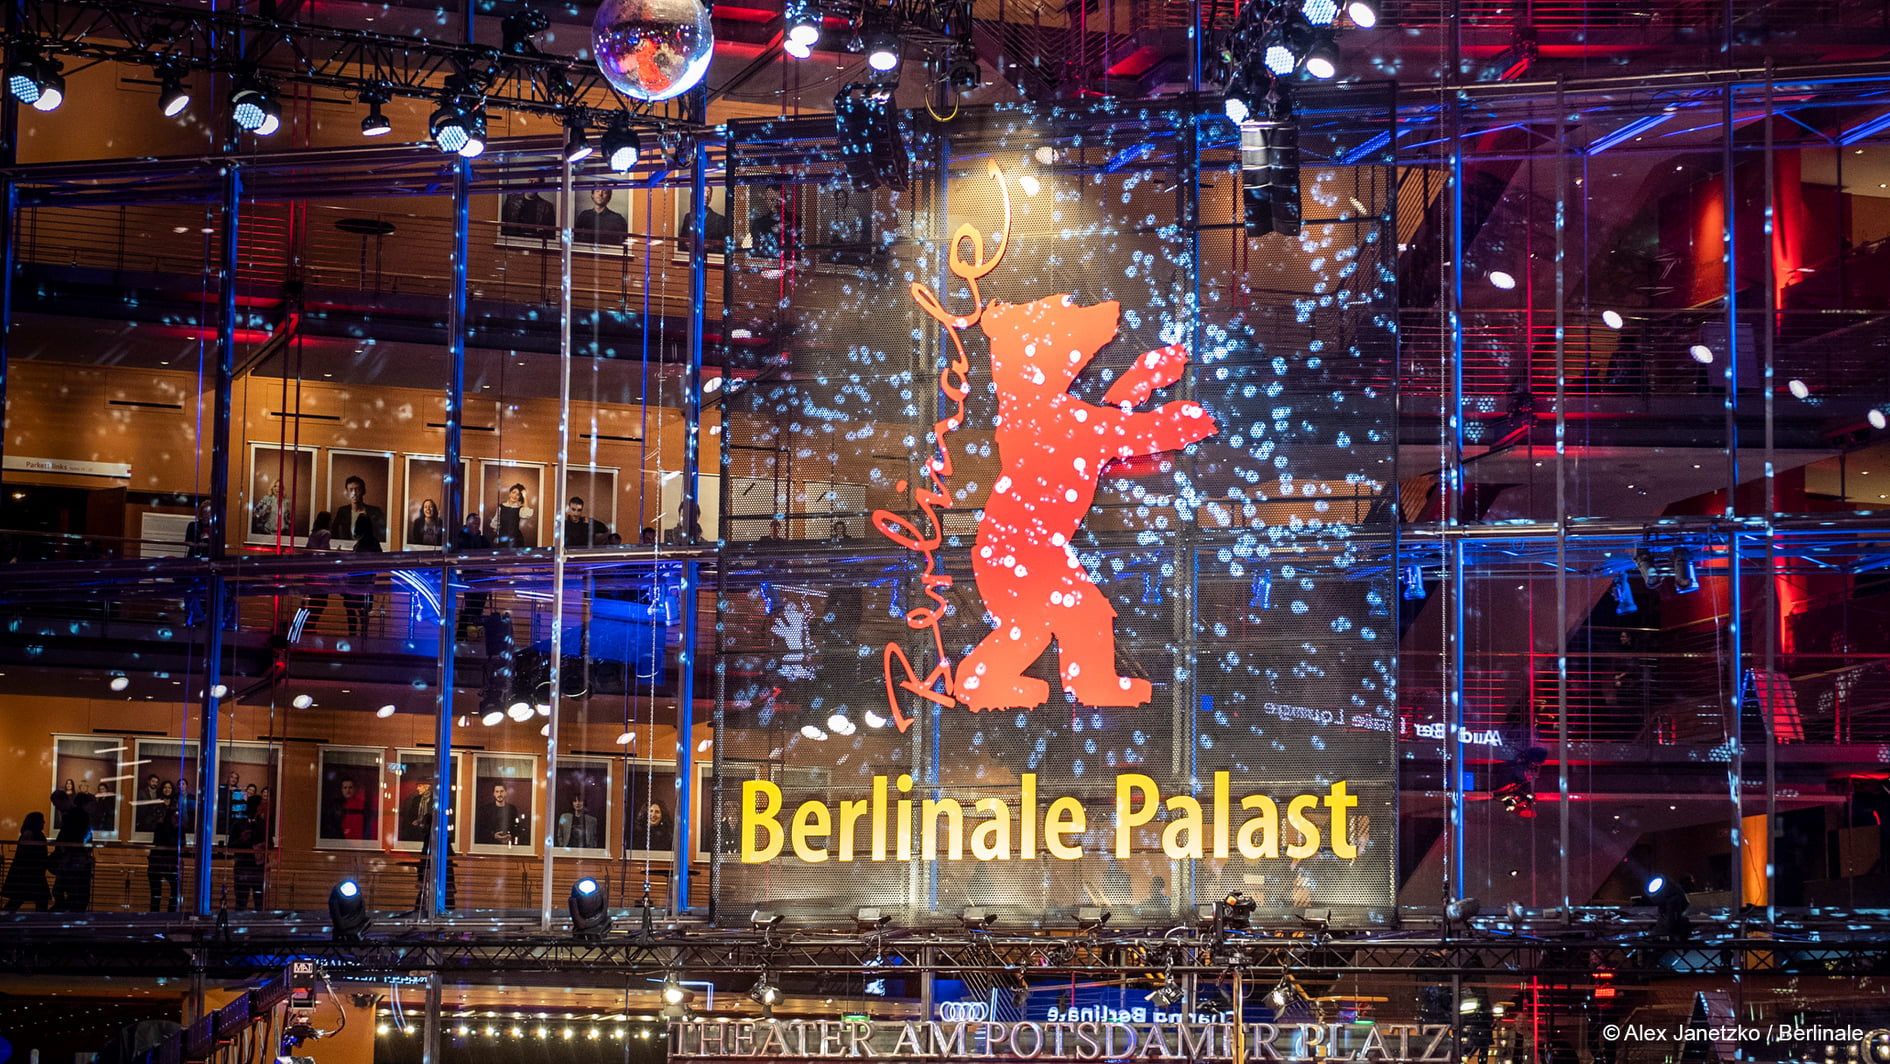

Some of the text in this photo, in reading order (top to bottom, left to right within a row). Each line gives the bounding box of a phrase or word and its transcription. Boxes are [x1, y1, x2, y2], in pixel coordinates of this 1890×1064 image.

[872, 158, 1011, 734] Berlinale
[741, 770, 1358, 864] Berlinale Palast
[668, 1020, 1451, 1062] THEATER AM POTSDAMER PLATZ
